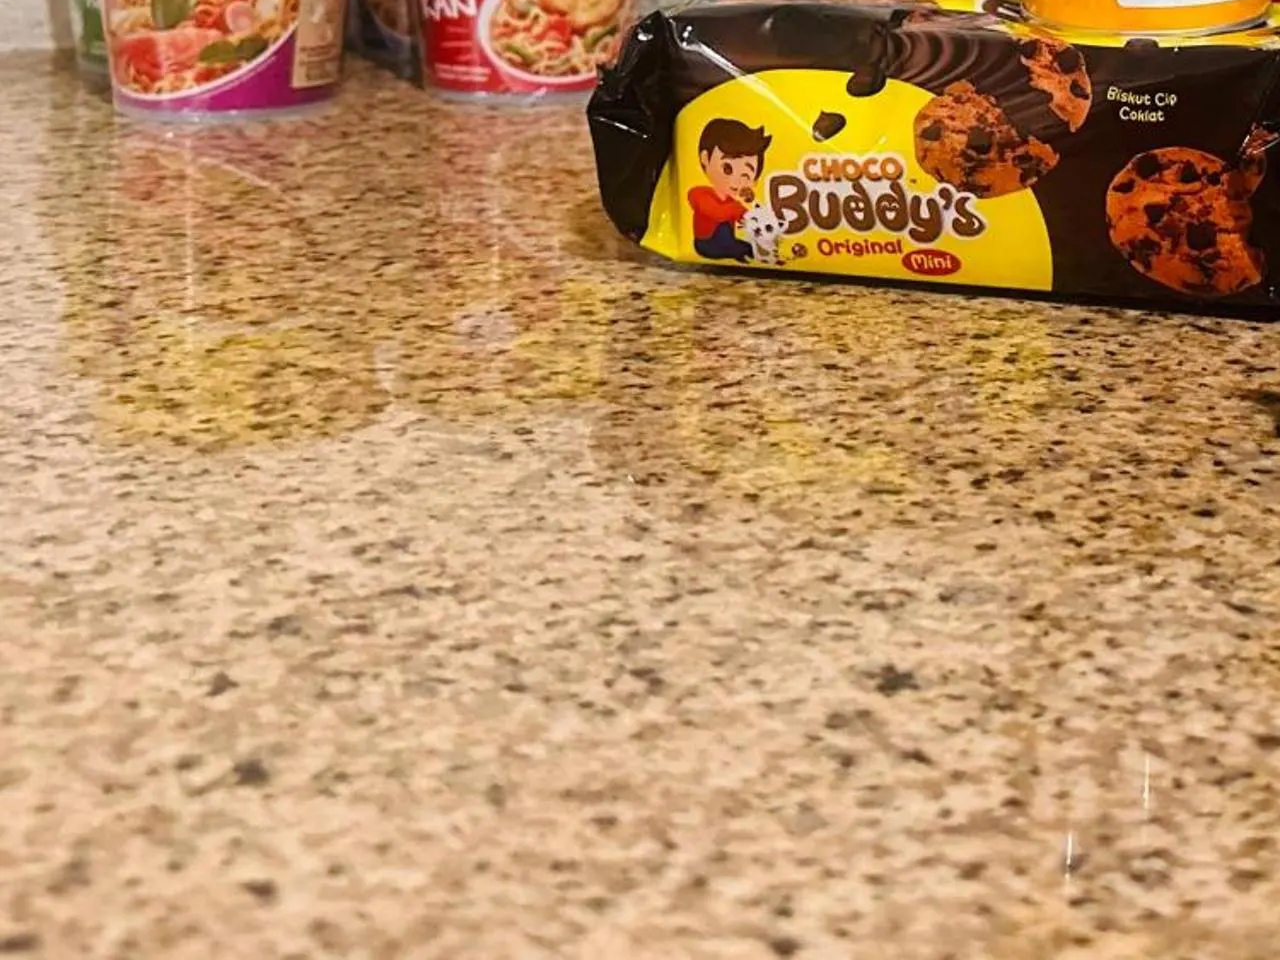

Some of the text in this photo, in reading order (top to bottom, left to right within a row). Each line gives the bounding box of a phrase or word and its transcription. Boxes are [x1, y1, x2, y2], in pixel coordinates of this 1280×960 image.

[1107, 85, 1178, 107] Biskut Cip
[1119, 106, 1165, 122] Coklat
[803, 156, 904, 183] CHOCO
[768, 174, 987, 244] Buddy's
[817, 239, 953, 271] Original Mini
